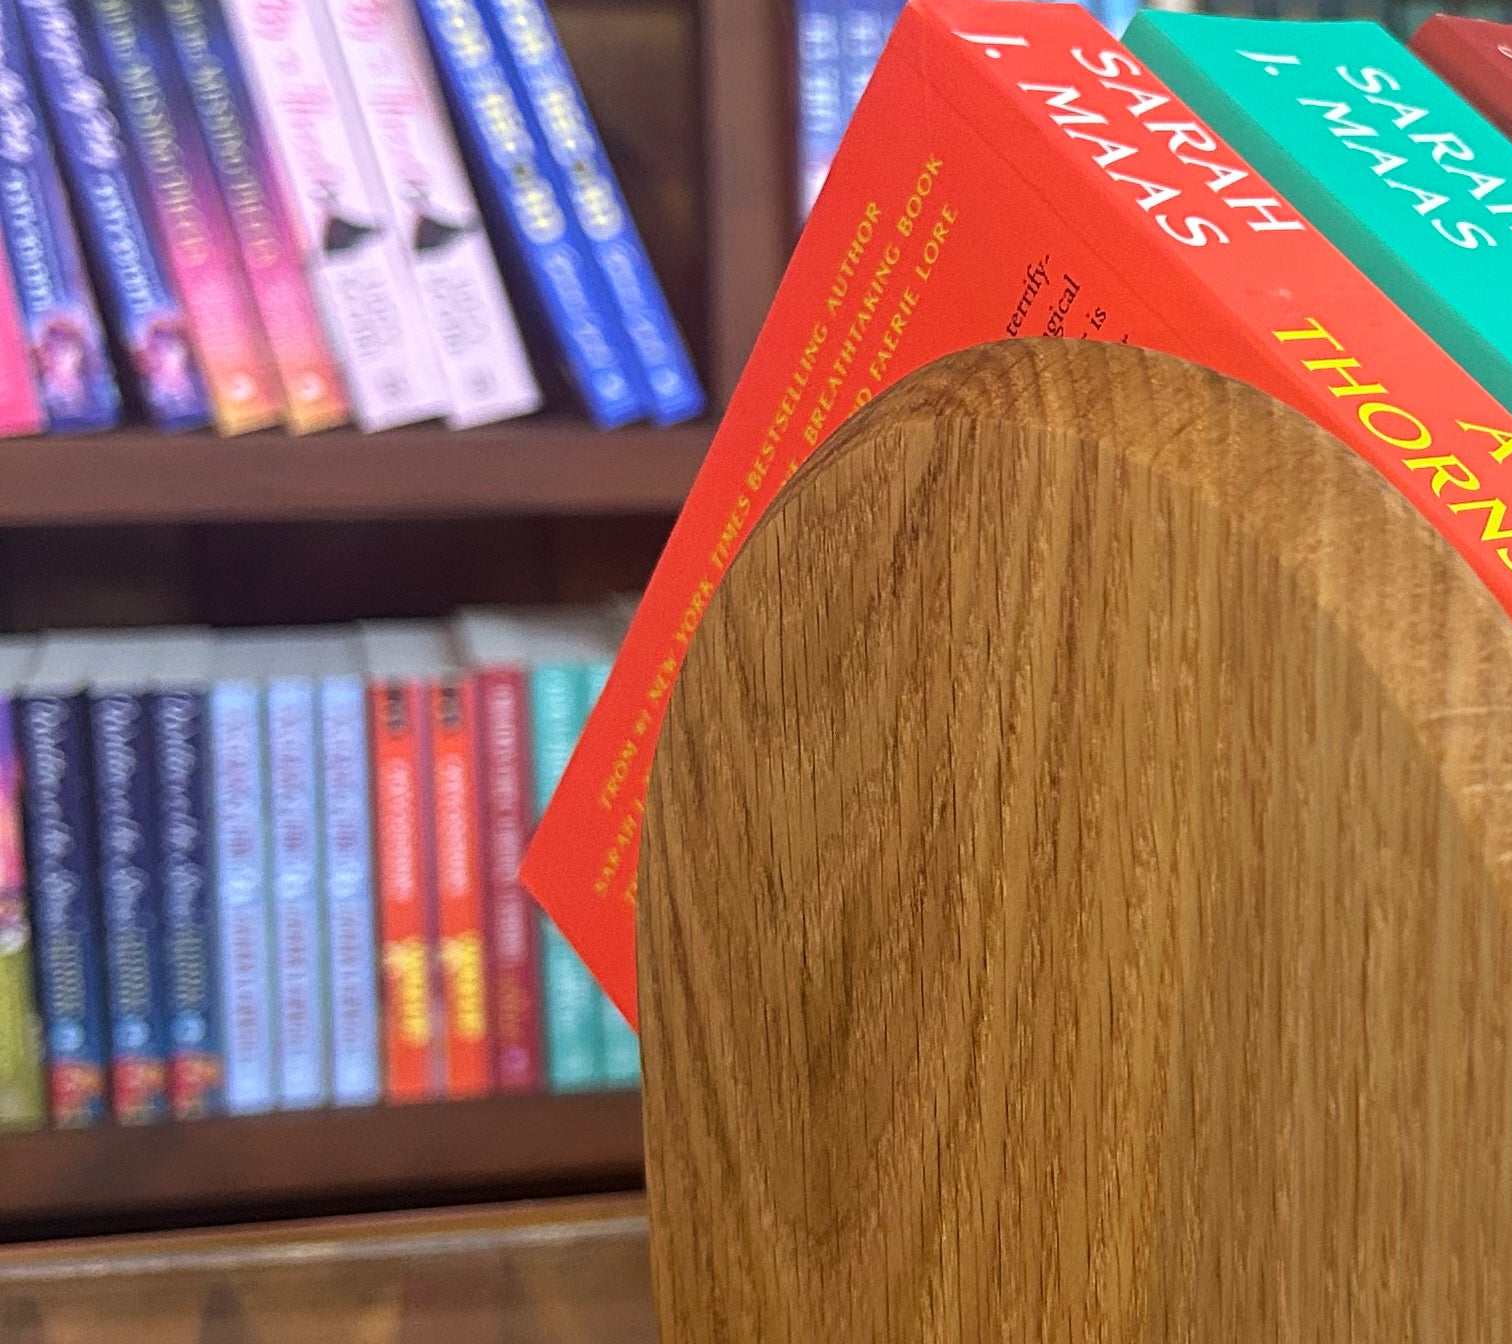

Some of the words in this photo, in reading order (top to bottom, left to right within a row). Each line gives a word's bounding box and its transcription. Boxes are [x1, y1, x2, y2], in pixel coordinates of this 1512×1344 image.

[952, 29, 1030, 60] J.
[1017, 81, 1230, 248] MAAS
[1070, 47, 1305, 232] SARAH
[1236, 49, 1301, 76] J.
[1296, 97, 1498, 249] MAAS
[803, 244, 901, 447] BREATHTAKING
[897, 153, 944, 237] BOOK
[870, 287, 921, 382] FAERIE
[915, 203, 959, 281] LORE
[1006, 255, 1050, 337] terrify-
[1085, 307, 1107, 330] is
[600, 738, 638, 811] FROM
[648, 649, 677, 704] NEW
[675, 577, 713, 645] YORK
[711, 495, 750, 570] TIMES
[746, 322, 828, 492] BESTSELLING
[827, 201, 881, 317] AUTHOR
[593, 812, 637, 897] SARAH
